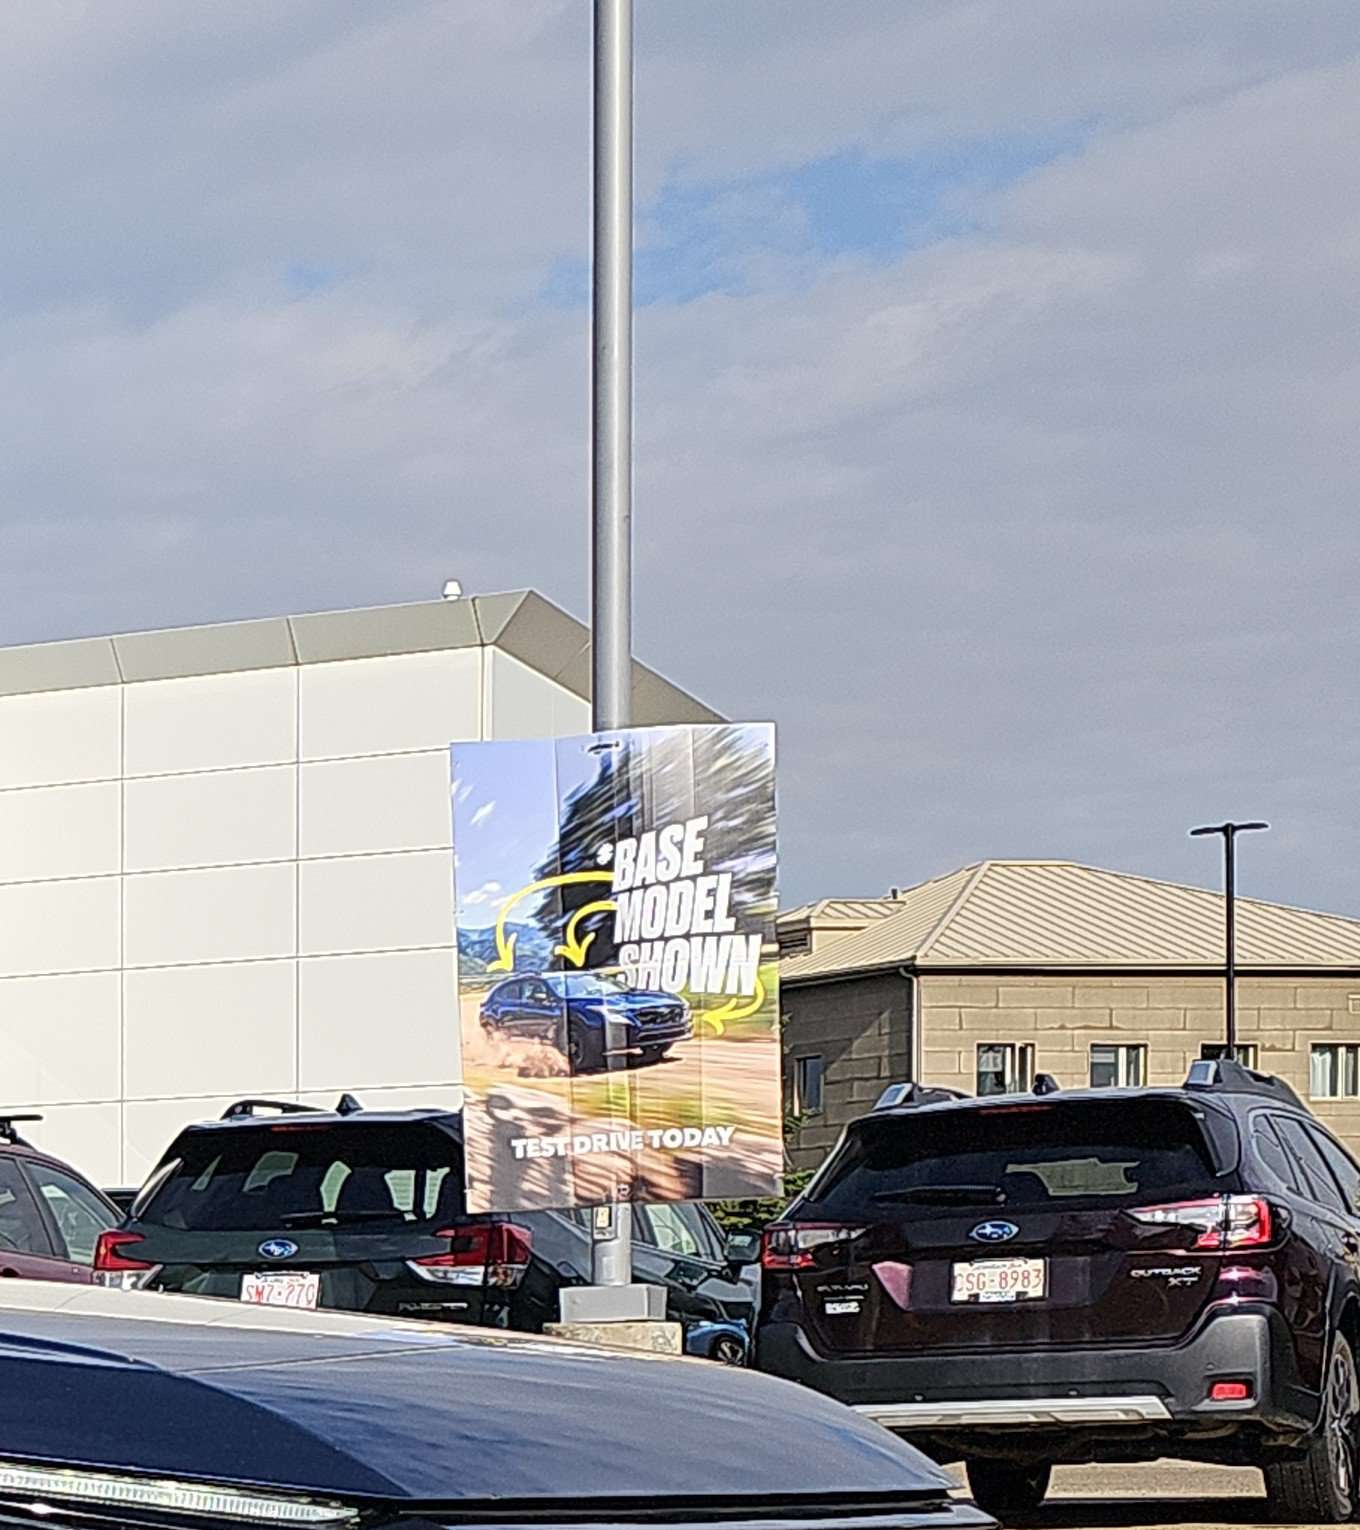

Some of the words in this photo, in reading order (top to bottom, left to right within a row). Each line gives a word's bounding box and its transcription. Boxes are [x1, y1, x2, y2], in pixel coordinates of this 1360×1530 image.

[613, 872, 737, 944] MODEL
[617, 934, 763, 996] SHOWN
[510, 1136, 571, 1160] TEST
[573, 1130, 644, 1154] DRIVE
[647, 1126, 736, 1149] TODAY
